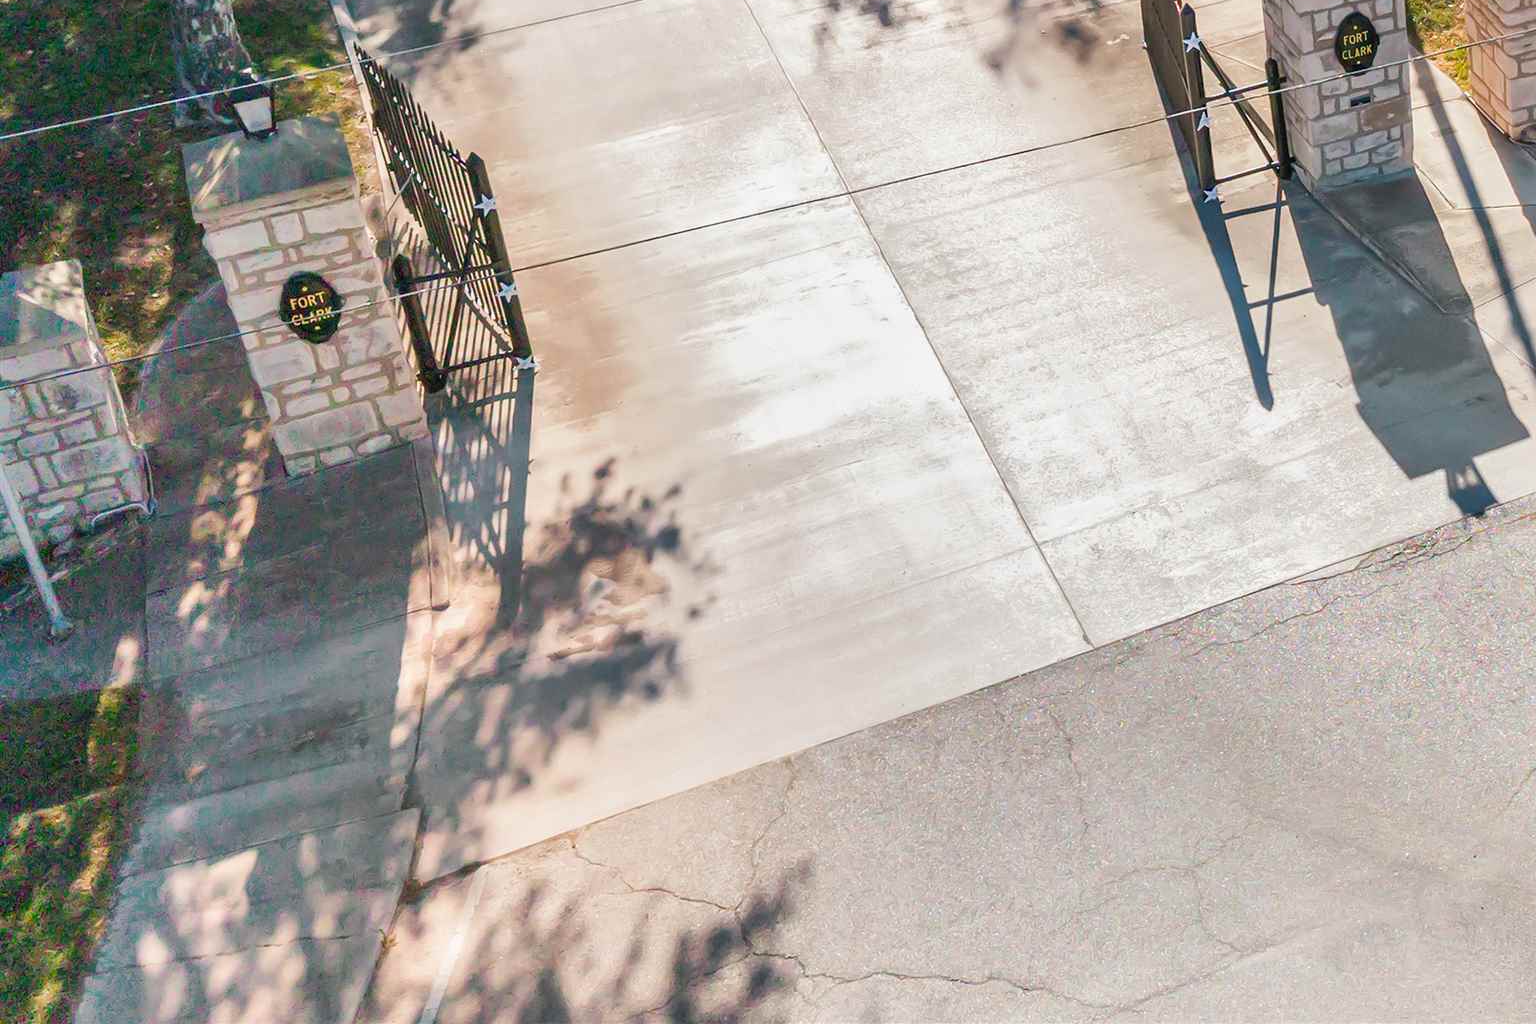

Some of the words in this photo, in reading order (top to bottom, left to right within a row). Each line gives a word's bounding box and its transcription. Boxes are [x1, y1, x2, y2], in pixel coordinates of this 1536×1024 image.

[1343, 31, 1368, 46] FORT
[1342, 45, 1372, 60] CLARK
[290, 291, 325, 310] FORT
